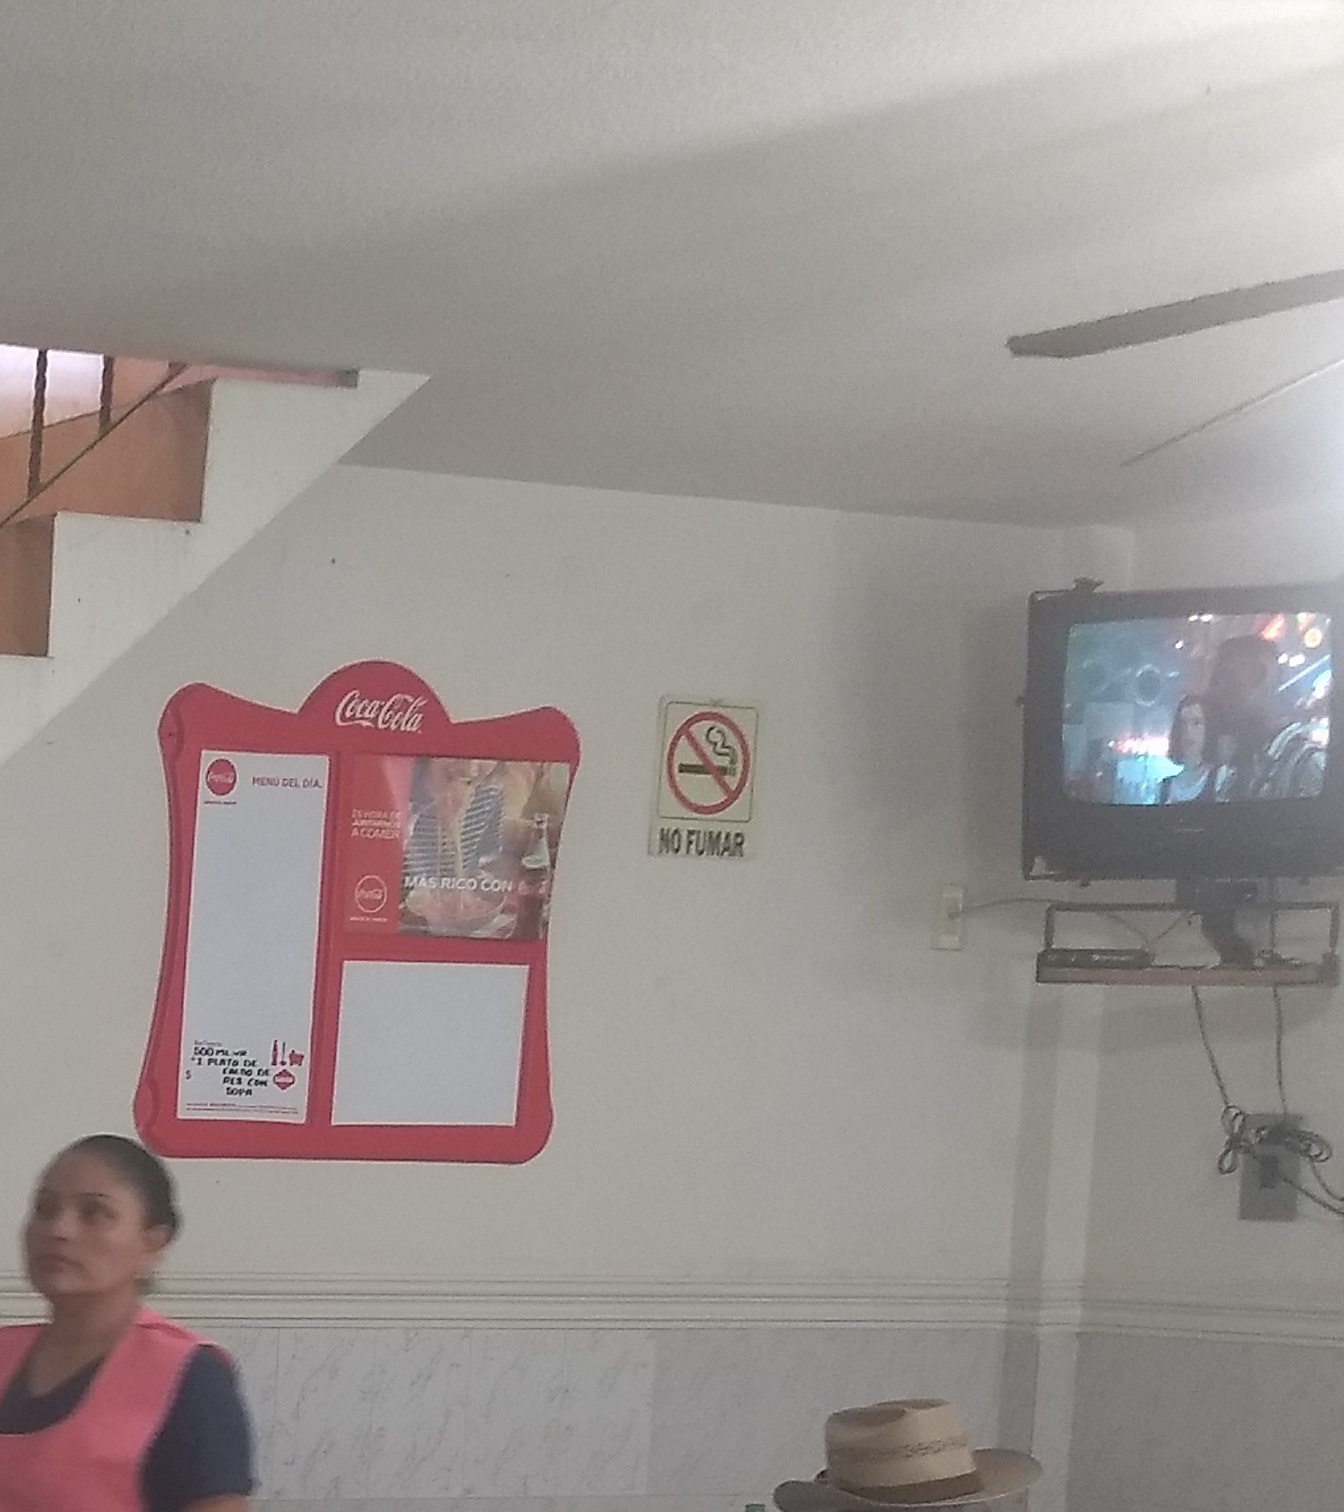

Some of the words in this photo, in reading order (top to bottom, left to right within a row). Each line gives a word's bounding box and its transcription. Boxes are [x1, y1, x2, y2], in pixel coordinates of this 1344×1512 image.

[335, 689, 428, 733] Coca-Cola
[281, 777, 300, 788] DEL
[658, 827, 681, 854] NO
[685, 829, 745, 858] FUMAR
[440, 877, 478, 891] RICO
[480, 879, 512, 893] CON
[208, 1058, 239, 1067] PLATO
[243, 1059, 258, 1067] DE
[222, 1067, 253, 1077] CALDO
[257, 1068, 270, 1077] DE
[222, 1076, 243, 1086] RES
[247, 1077, 268, 1087] CON
[225, 1086, 253, 1096] SOPA
